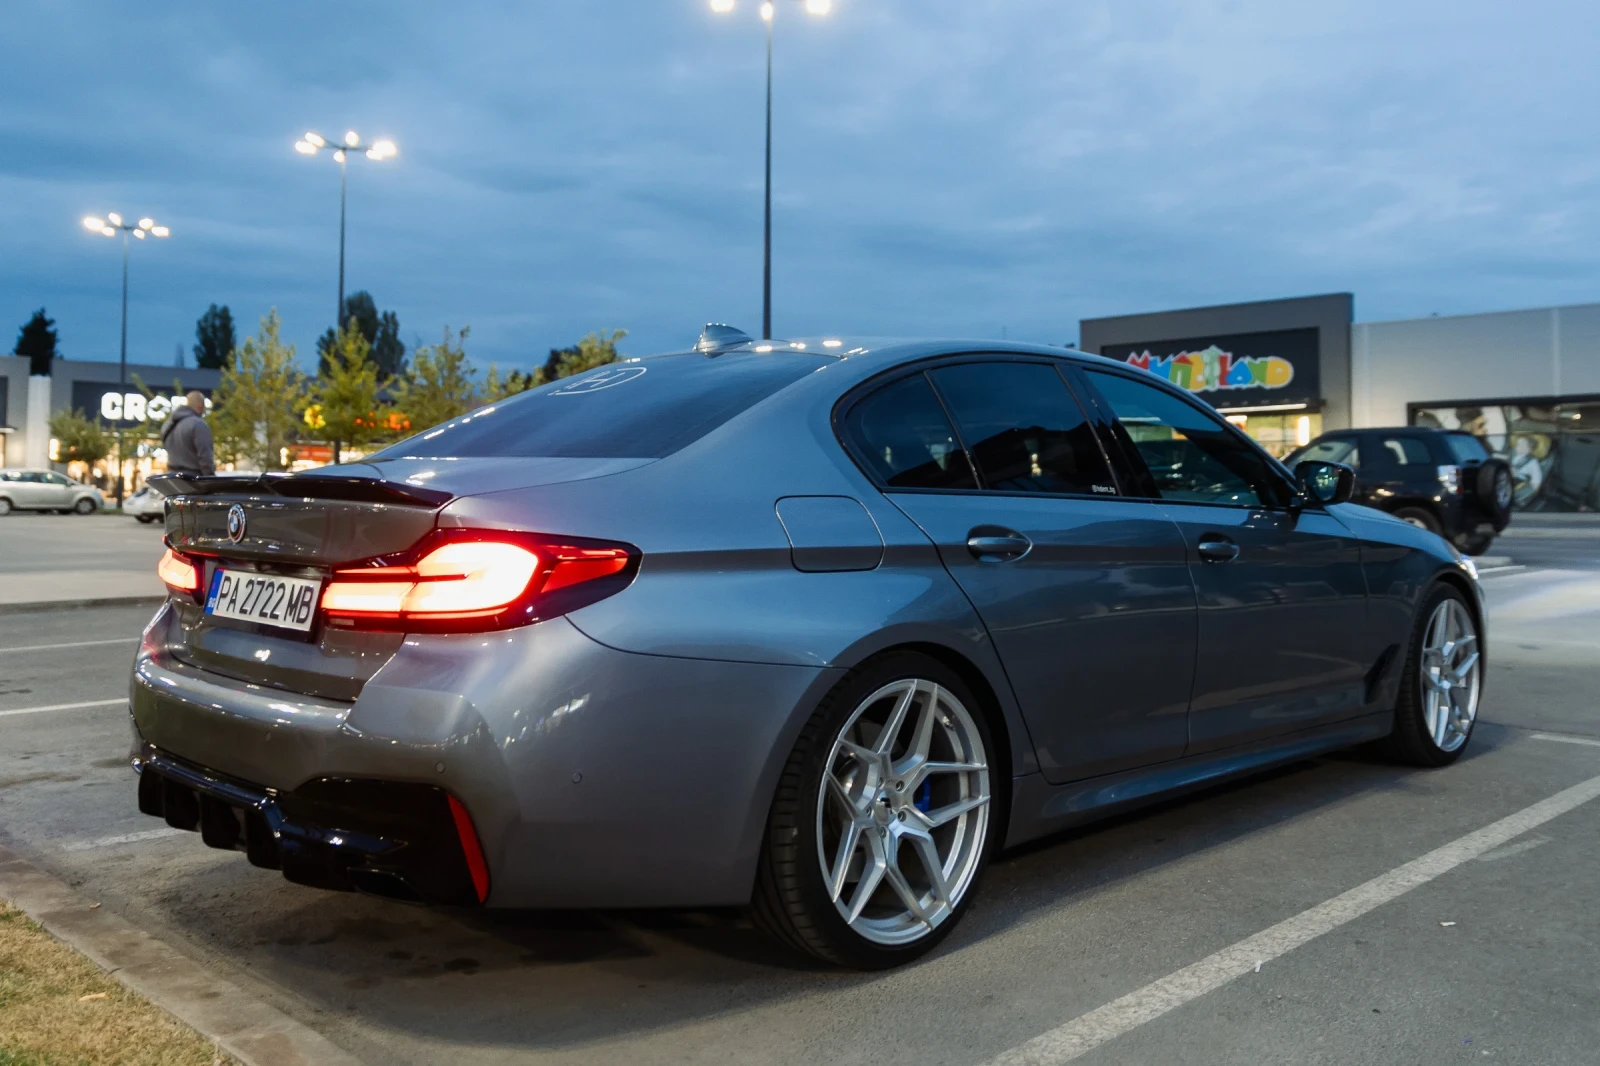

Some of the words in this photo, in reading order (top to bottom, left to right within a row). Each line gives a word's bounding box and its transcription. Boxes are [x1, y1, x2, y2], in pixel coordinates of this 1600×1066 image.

[101, 392, 213, 422] CRO
[217, 575, 241, 612] PA
[239, 578, 286, 620] 2722
[284, 583, 314, 624] MB
